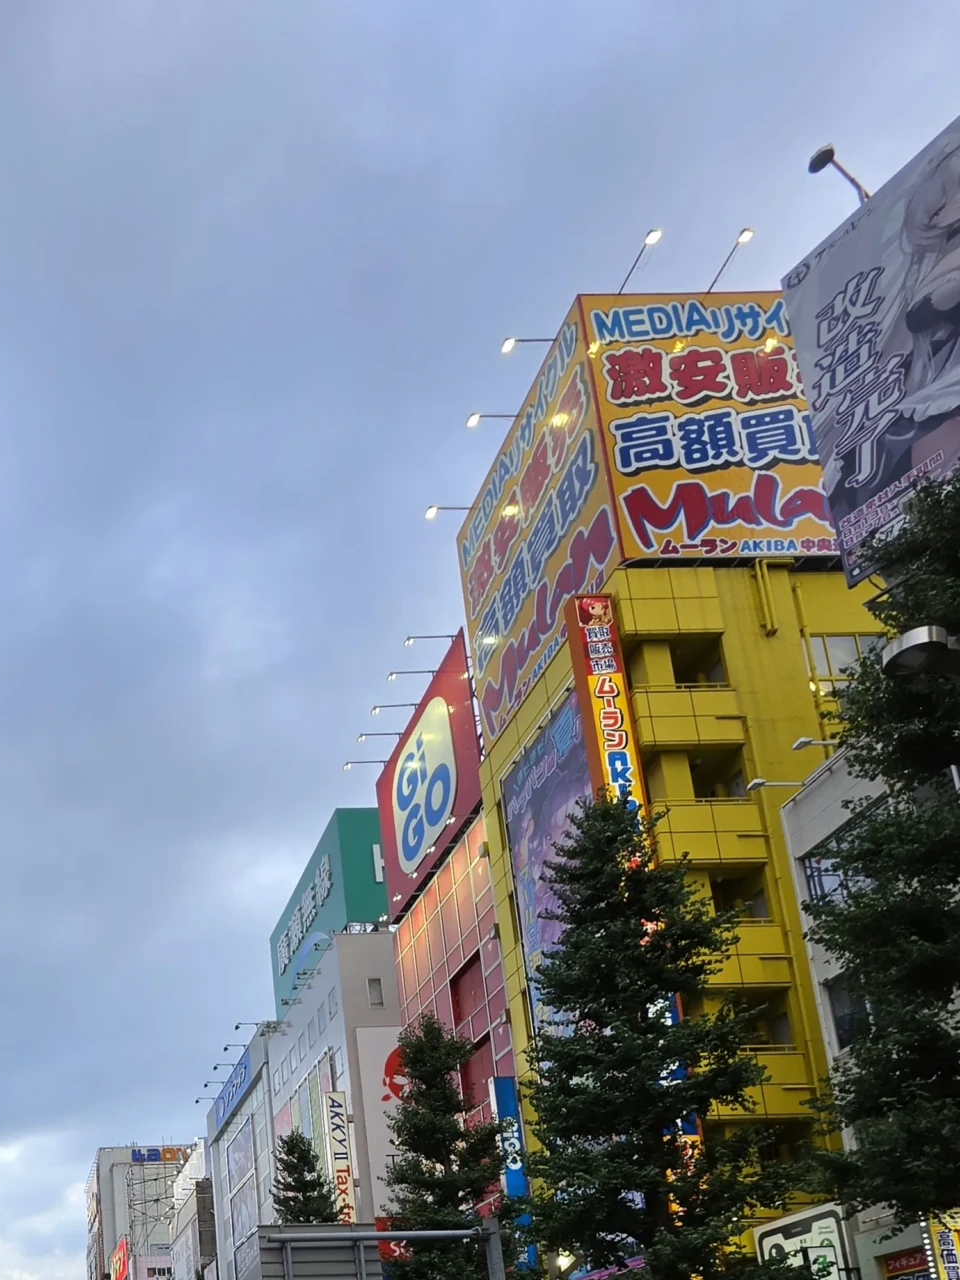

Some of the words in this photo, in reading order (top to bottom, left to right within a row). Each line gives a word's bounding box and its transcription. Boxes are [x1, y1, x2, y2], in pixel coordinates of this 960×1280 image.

[614, 409, 818, 470] 高額買
[659, 538, 736, 556] ムーラン
[740, 540, 798, 553] AKIBA
[799, 538, 841, 554] 中央
[587, 627, 611, 640] 買取
[588, 643, 613, 656] 販売
[595, 676, 628, 750] ムーラン
